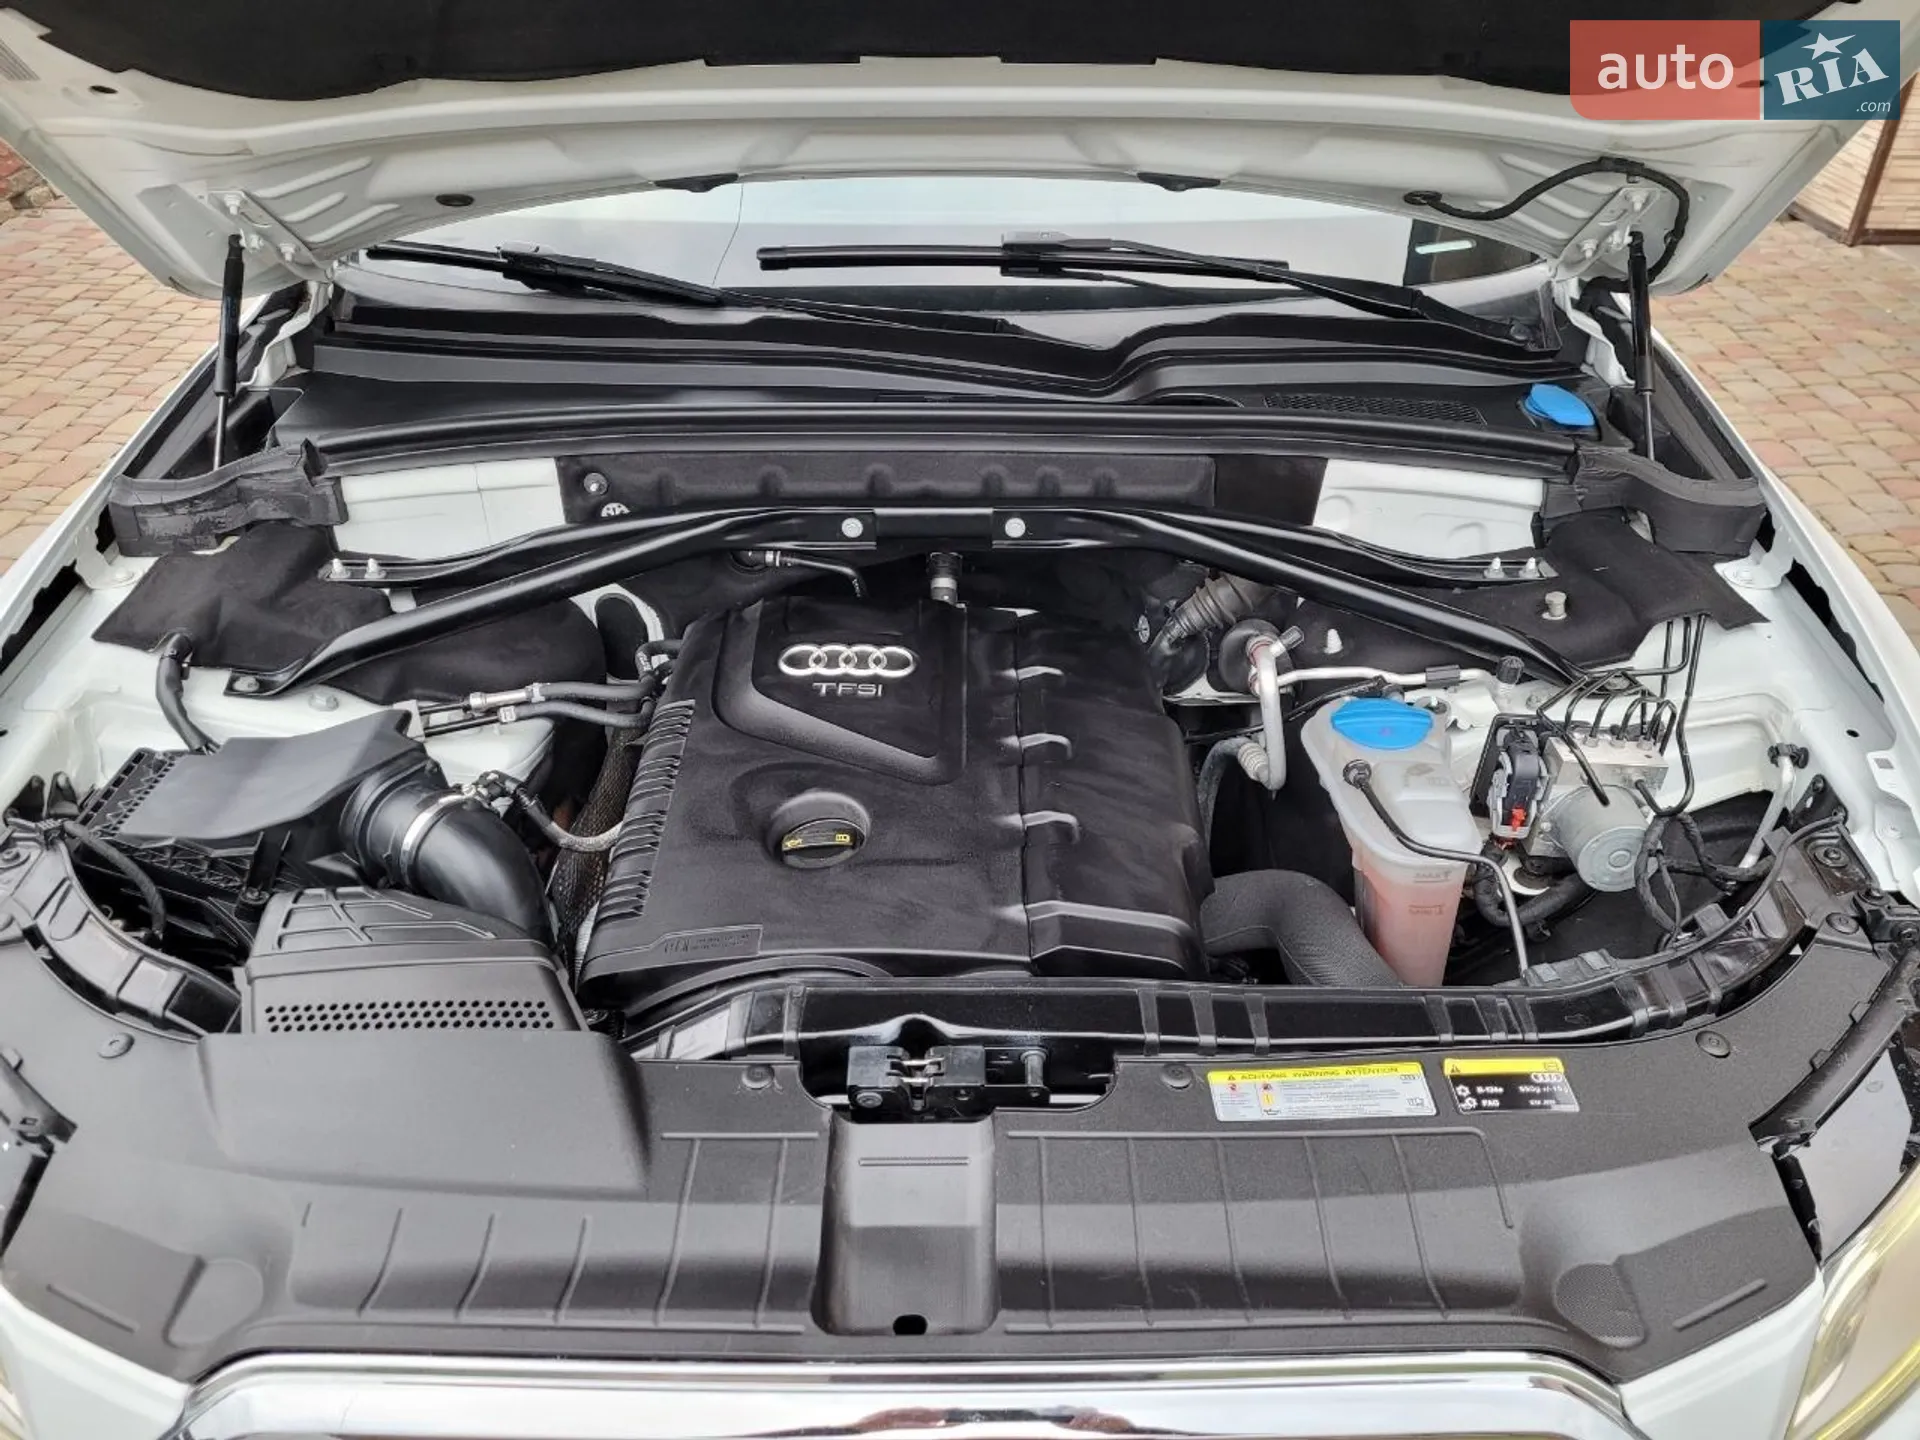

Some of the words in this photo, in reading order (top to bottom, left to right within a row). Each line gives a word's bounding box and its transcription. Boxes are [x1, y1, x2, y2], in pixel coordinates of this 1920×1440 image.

[812, 682, 883, 697] TFSI
[1292, 1069, 1340, 1078] WARNING
[1345, 1067, 1399, 1076] ATTENTION
